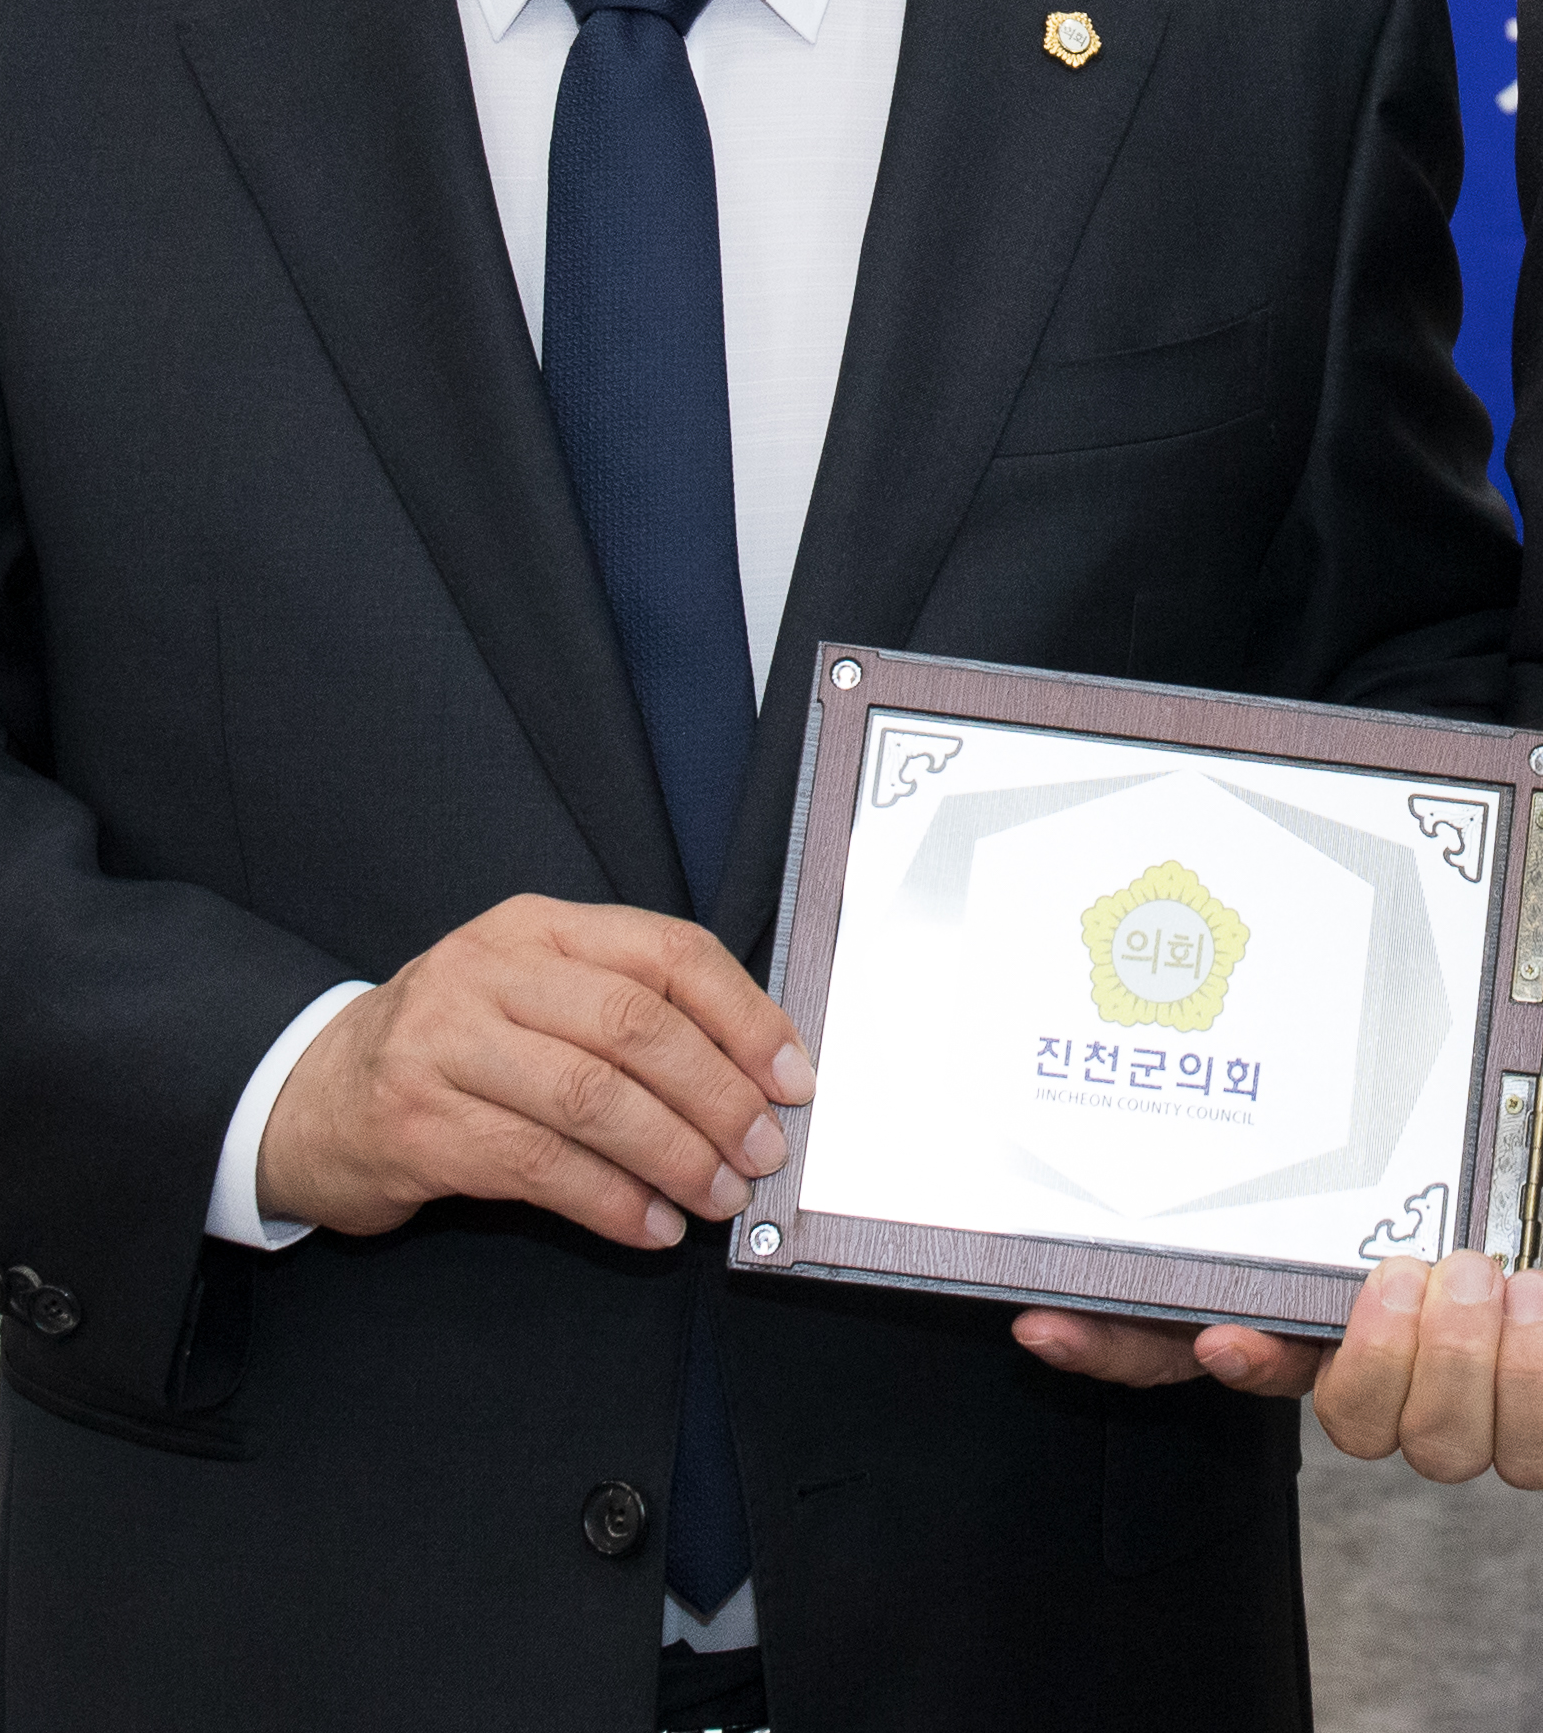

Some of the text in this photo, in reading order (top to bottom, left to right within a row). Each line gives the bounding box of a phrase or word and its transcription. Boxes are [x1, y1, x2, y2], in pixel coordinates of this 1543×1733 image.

[1121, 928, 1205, 980] 의회
[1037, 1036, 1261, 1102] 진천군의회
[1035, 1087, 1256, 1126] JINCHEON COUNTY COUNCIL
